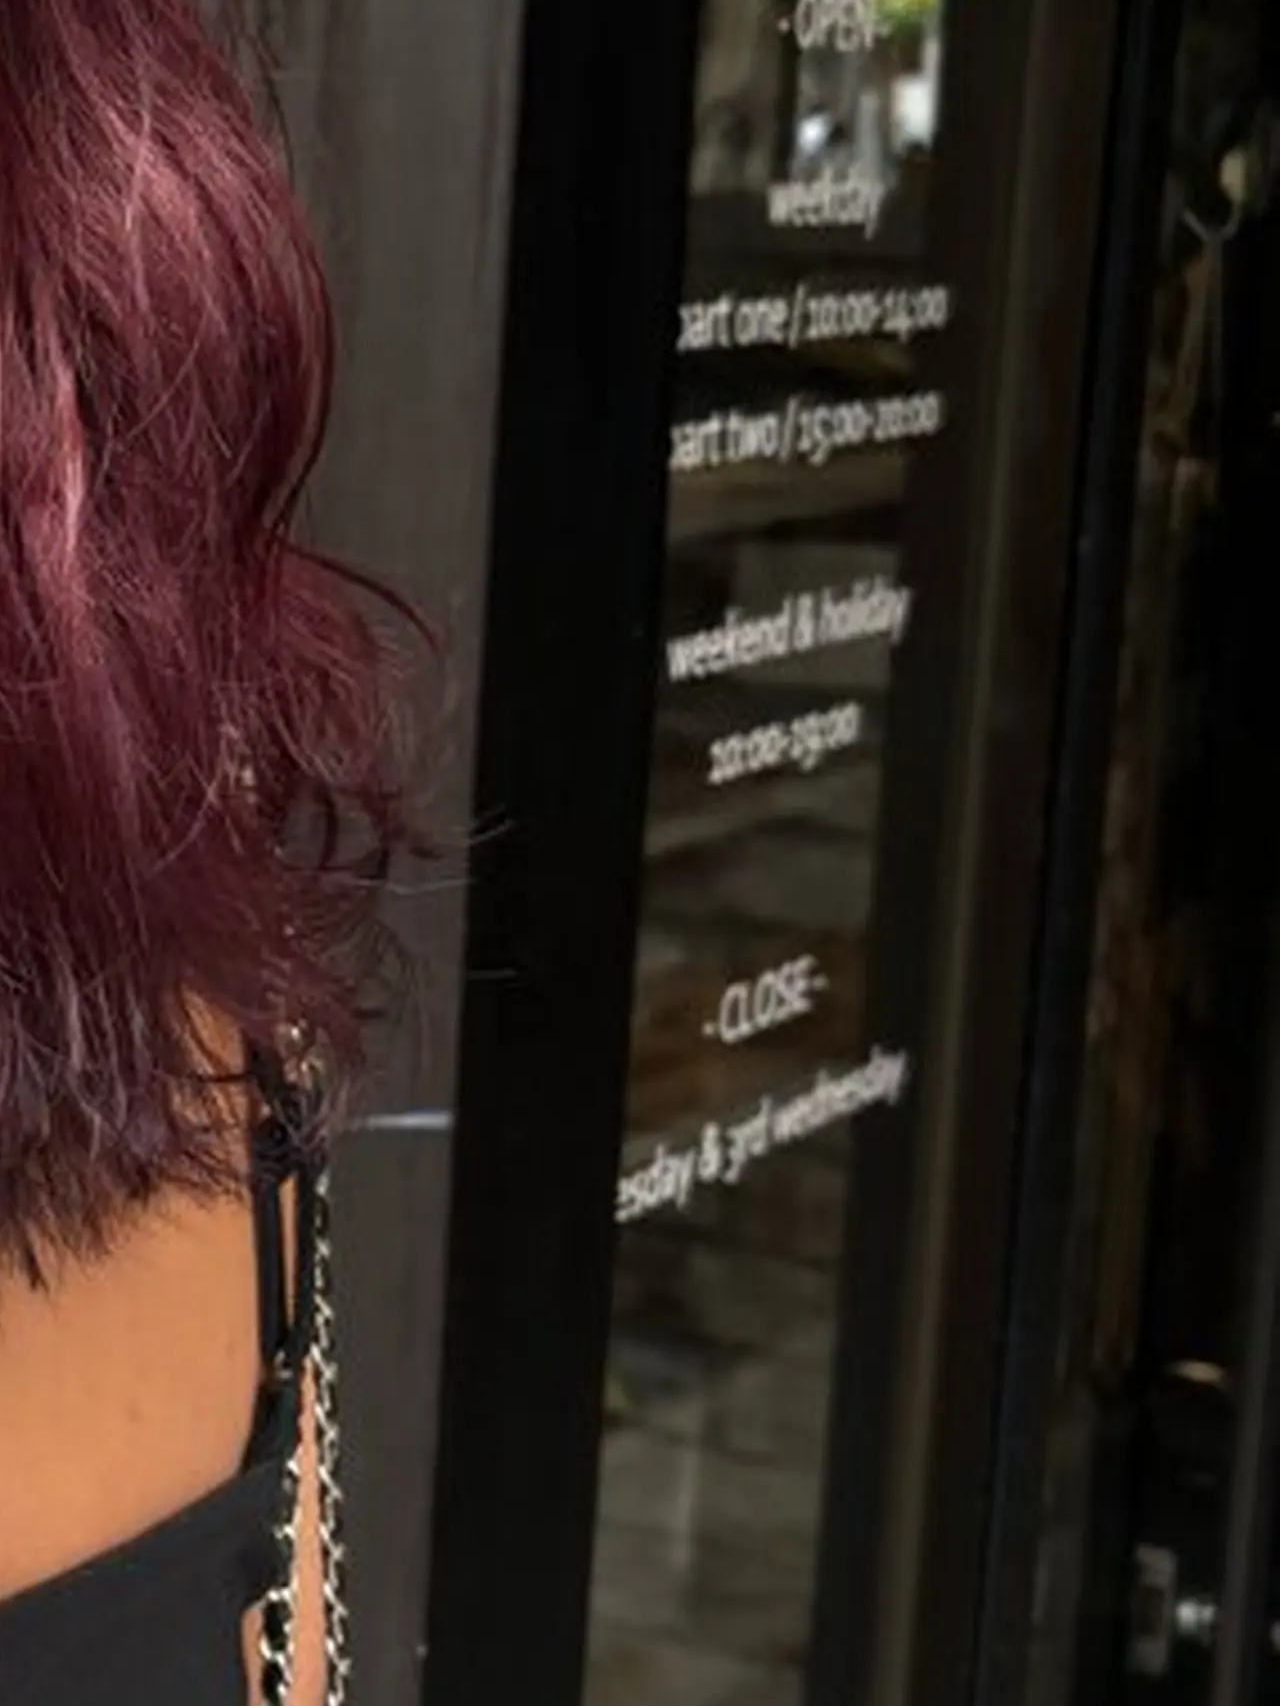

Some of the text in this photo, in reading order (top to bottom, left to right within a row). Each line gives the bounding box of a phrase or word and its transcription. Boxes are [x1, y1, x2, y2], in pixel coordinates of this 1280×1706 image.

[768, 161, 885, 240] weekday
[735, 297, 788, 345] one
[807, 285, 948, 341] 10:00-14:00
[725, 407, 780, 463] two
[666, 574, 912, 681] weekend & holiday
[697, 1121, 721, 1182] &
[724, 1096, 772, 1182] 3rd
[773, 1046, 906, 1141] wednesday
